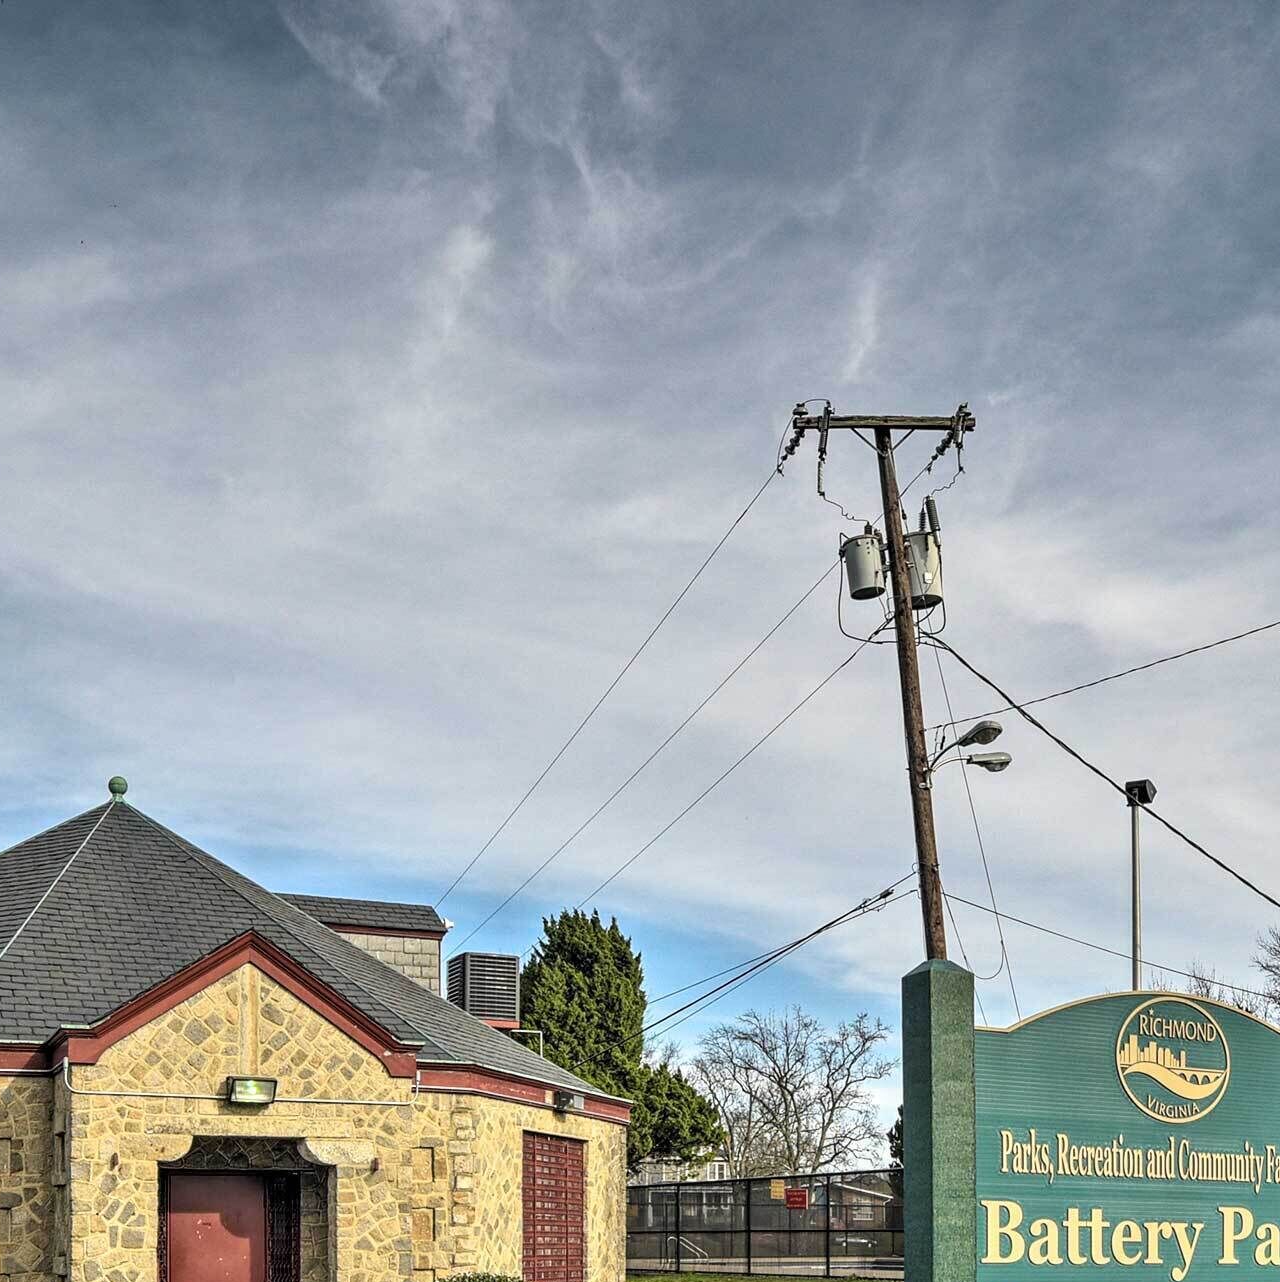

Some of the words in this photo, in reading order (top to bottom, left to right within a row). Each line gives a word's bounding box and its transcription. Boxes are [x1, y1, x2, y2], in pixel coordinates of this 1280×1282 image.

[1139, 1012, 1217, 1042] RICHMOND
[1147, 1094, 1200, 1118] VIRGINIA
[1000, 1129, 1055, 1184] Parks,
[1056, 1133, 1144, 1179] Recreation
[1147, 1136, 1176, 1180] and
[1178, 1139, 1265, 1193] Community
[980, 1199, 1205, 1282] Battery
